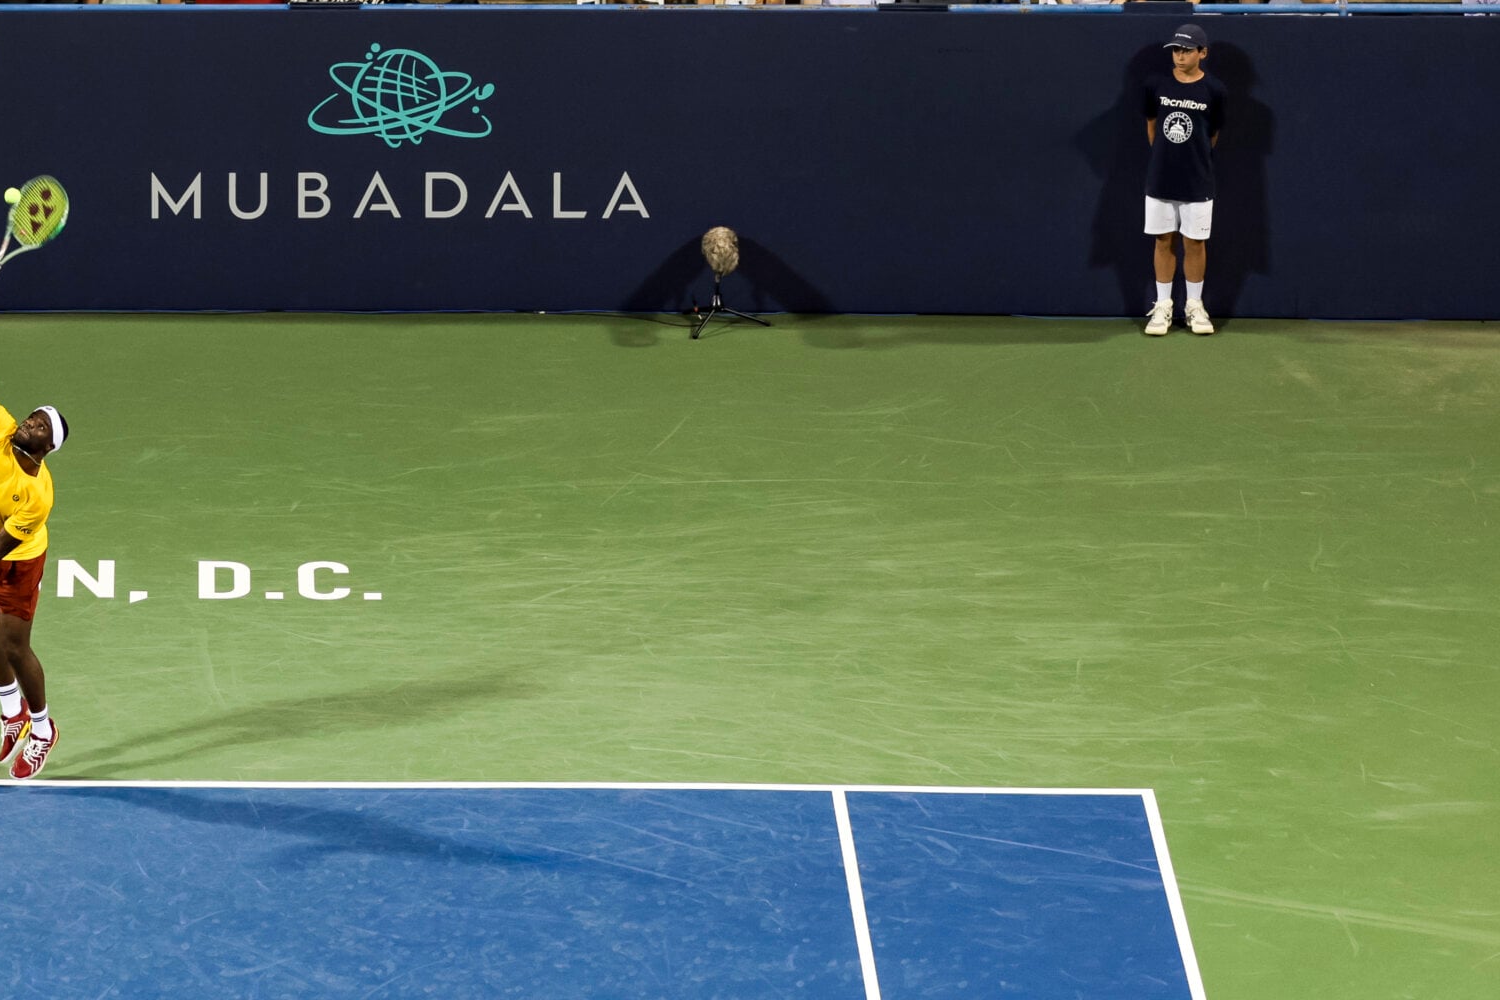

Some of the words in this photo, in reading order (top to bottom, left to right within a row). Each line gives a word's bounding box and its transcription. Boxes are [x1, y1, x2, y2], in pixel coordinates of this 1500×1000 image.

[1159, 96, 1208, 111] Tecnifibre
[151, 171, 650, 220] MUBADALA
[198, 560, 382, 600] D.C.
